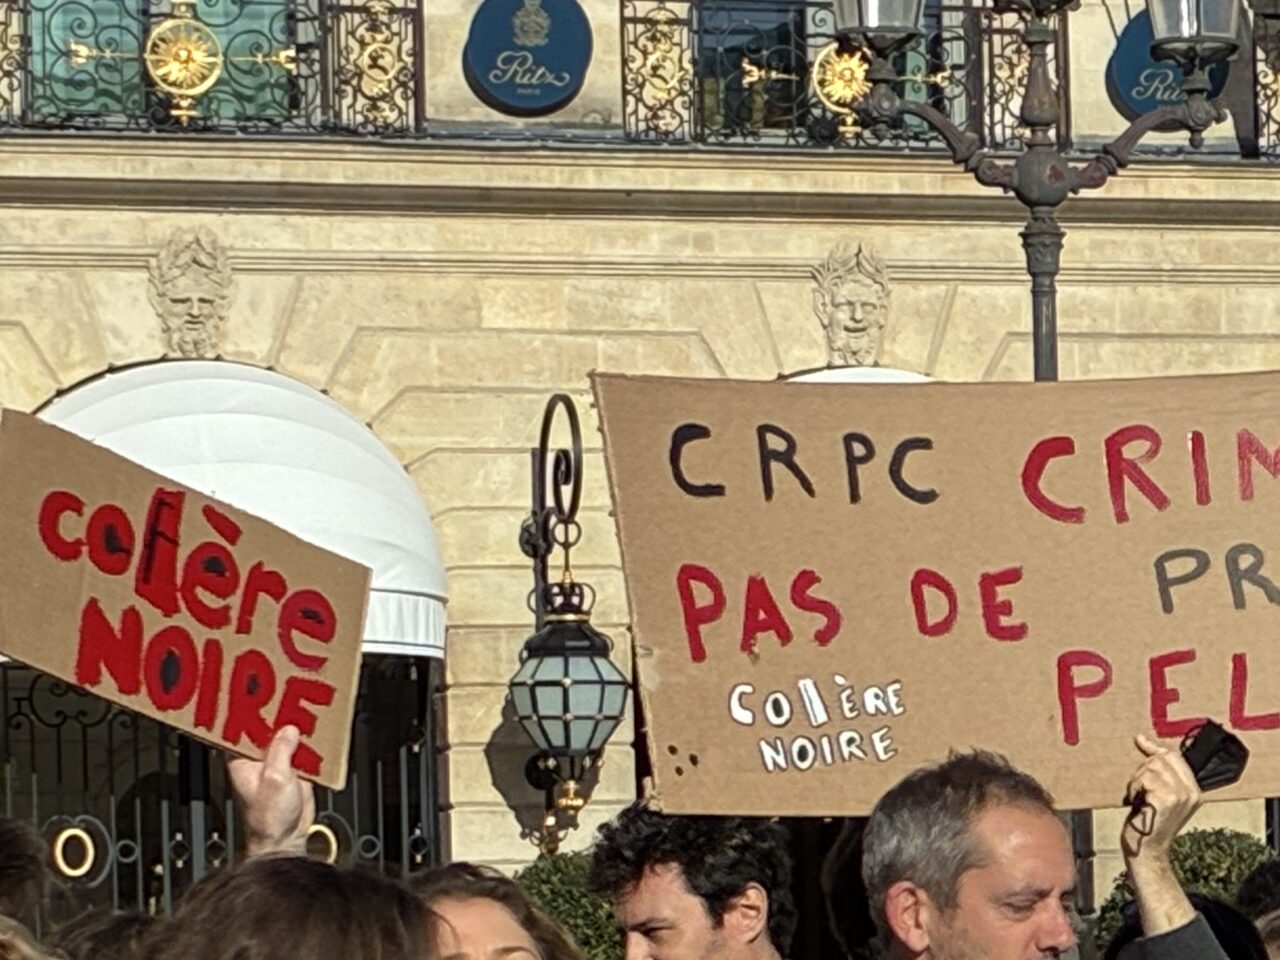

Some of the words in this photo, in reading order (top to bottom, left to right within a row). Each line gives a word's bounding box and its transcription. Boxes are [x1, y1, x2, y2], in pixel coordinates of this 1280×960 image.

[489, 50, 571, 87] Ritz
[668, 423, 940, 505] CRPC
[676, 563, 844, 664] PAS
[910, 565, 1030, 643] DE
[75, 596, 338, 777] NOIRE
[759, 727, 897, 773] NOIRE
